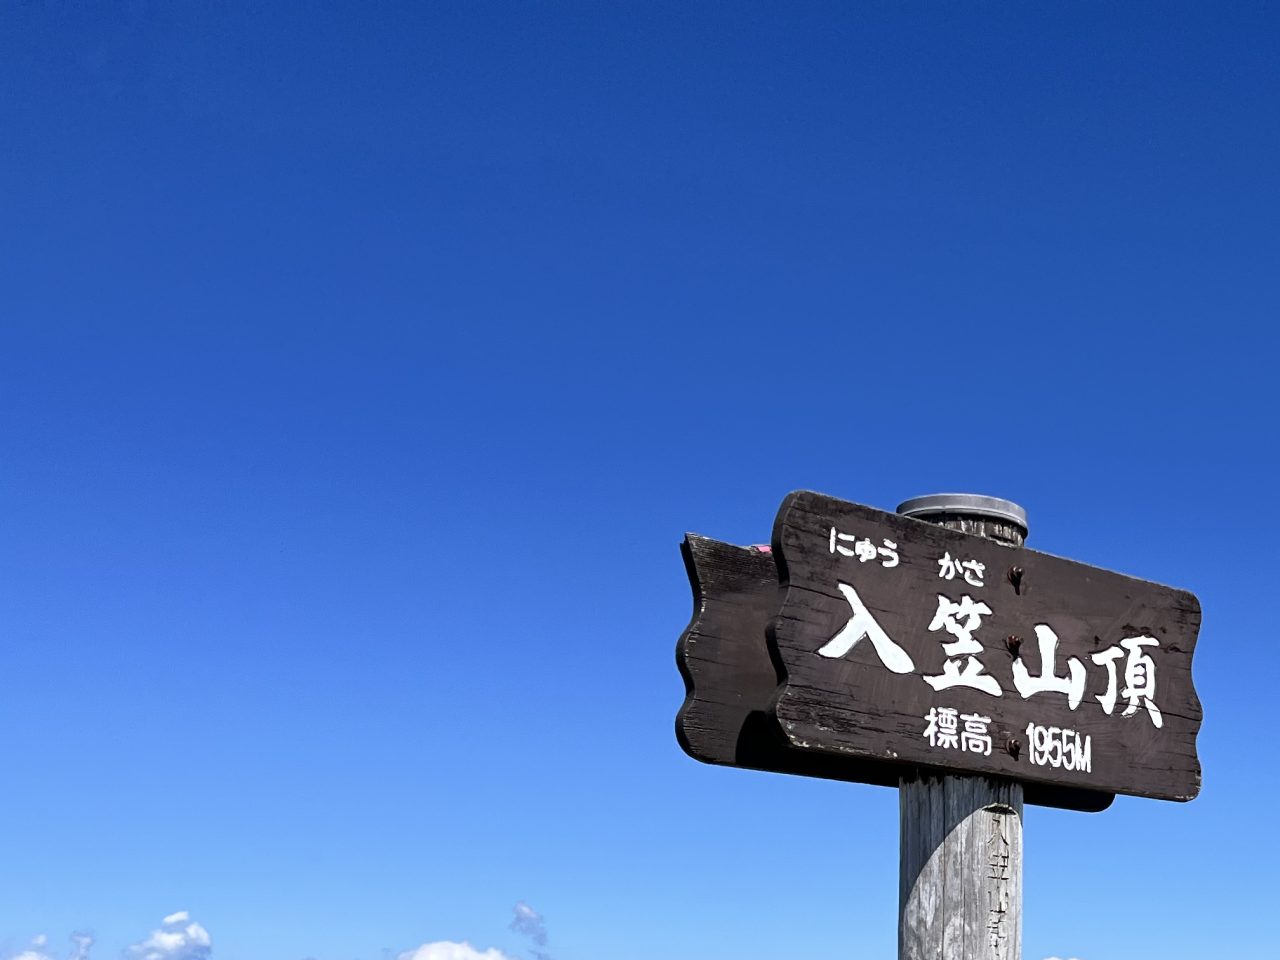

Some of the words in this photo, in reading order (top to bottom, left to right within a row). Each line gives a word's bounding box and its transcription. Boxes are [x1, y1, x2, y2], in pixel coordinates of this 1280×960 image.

[829, 526, 900, 568] にゅう
[938, 551, 986, 587] かさ
[817, 583, 1163, 729] 入笠山頂
[922, 707, 992, 756] 標高
[1025, 722, 1092, 773] 1955M
